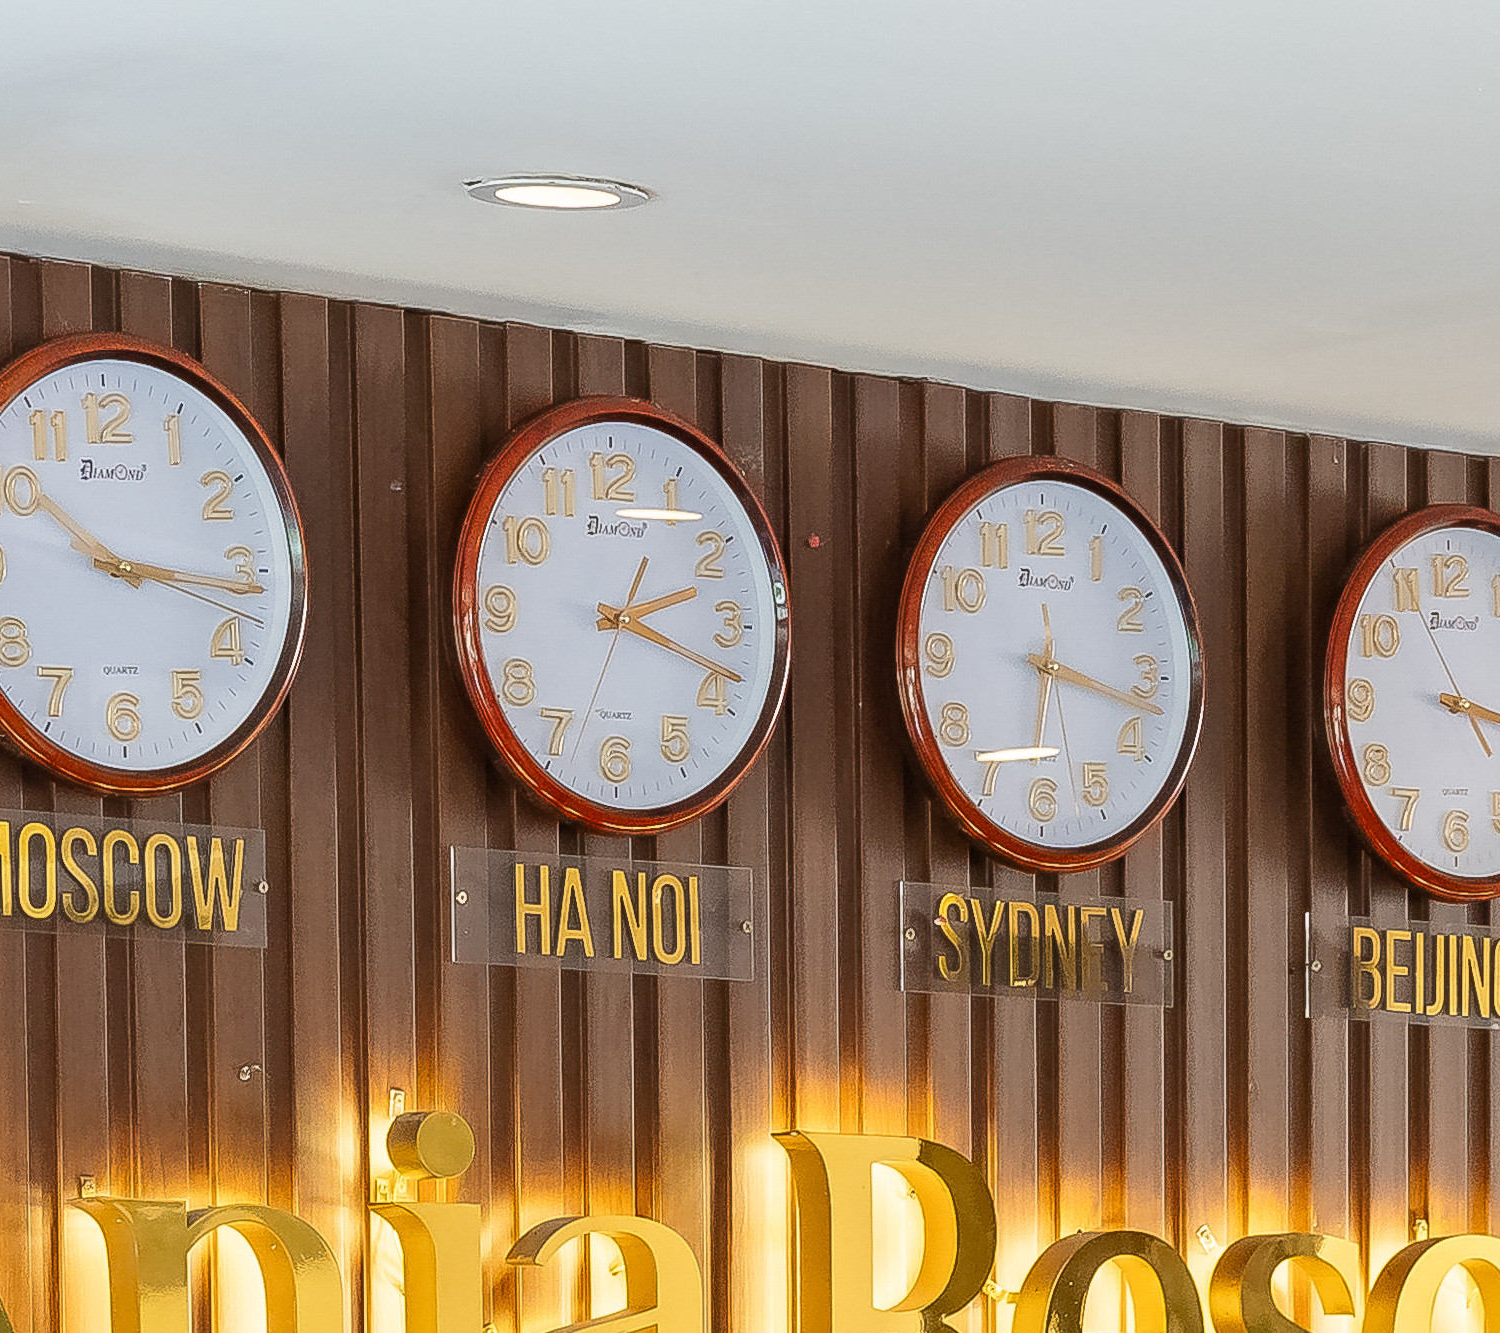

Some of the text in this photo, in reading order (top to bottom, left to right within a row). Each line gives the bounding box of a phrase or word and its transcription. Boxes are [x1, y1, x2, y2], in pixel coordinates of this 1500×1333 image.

[29, 410, 67, 462] 11
[81, 393, 133, 444] 12
[163, 414, 180, 466] 1
[200, 470, 233, 520] 2
[542, 467, 575, 517] 11
[589, 452, 635, 502] 12
[664, 478, 678, 526] 1
[502, 515, 550, 566] 10
[695, 531, 725, 579] 2
[979, 522, 1009, 569] 11
[1023, 509, 1065, 556] 12
[223, 546, 254, 592] 3
[1089, 535, 1102, 581] 1
[1430, 554, 1470, 597] 12
[484, 585, 518, 633] 9
[940, 566, 986, 614] 10
[1117, 587, 1145, 632] 2
[1392, 567, 1419, 612] 11
[210, 616, 243, 666] 4
[712, 600, 743, 648] 3
[1360, 614, 1401, 658] 10
[103, 666, 139, 676] QUARTZ
[925, 632, 955, 678] 9
[1131, 654, 1158, 699] 3
[37, 667, 74, 717] 7
[171, 670, 204, 719] 5
[502, 658, 536, 706] 8
[696, 670, 728, 715] 4
[1347, 677, 1375, 722] 9
[106, 692, 141, 742] 6
[539, 707, 573, 756] 7
[599, 710, 632, 721] QUARTZ
[660, 715, 690, 762] 5
[939, 701, 971, 747] 8
[599, 735, 631, 784] 6
[1117, 717, 1144, 762] 4
[1082, 762, 1108, 807] 5
[1363, 743, 1391, 787] 8
[1028, 778, 1058, 823] 6
[1388, 787, 1420, 831] 7
[1443, 809, 1469, 852] 6
[515, 863, 700, 964] HA NOI
[938, 892, 1144, 994] SYDNEY
